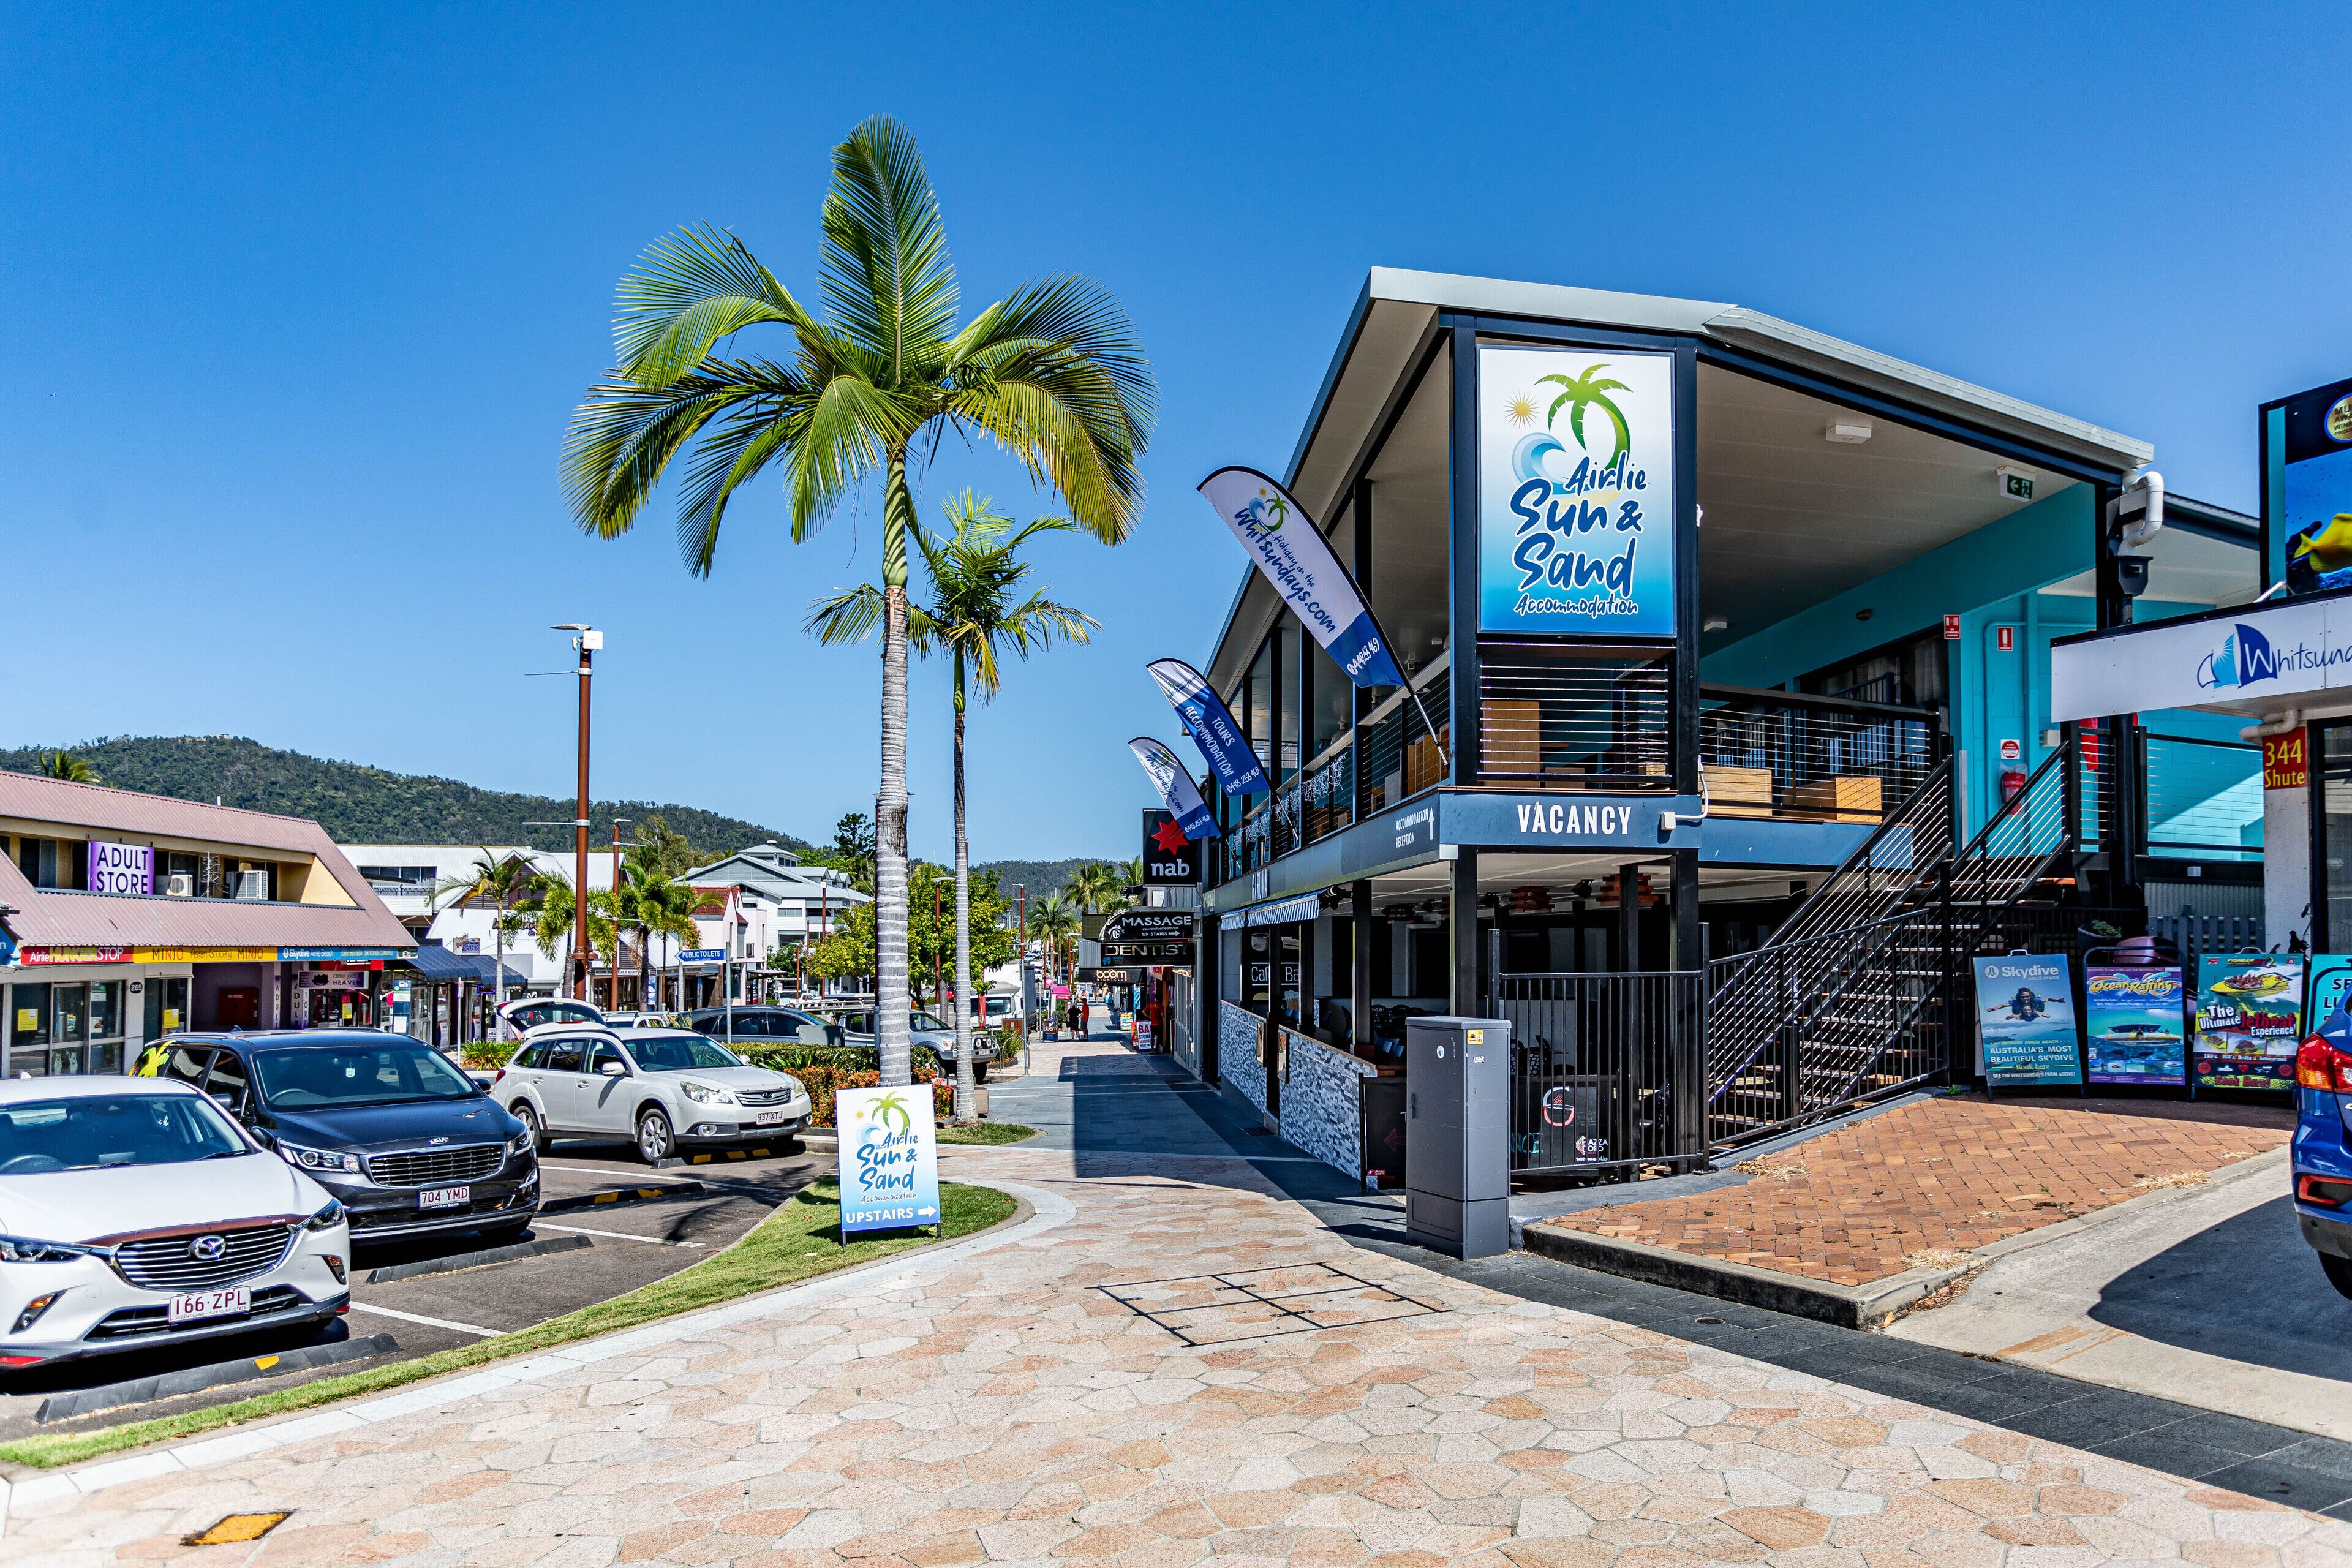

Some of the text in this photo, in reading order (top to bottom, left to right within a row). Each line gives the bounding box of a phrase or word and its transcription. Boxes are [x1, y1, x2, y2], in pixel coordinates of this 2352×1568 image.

[1565, 451, 1646, 497] Airlie
[1510, 478, 1643, 537] Sun &
[1274, 535, 1314, 587] Holiday in the
[1513, 532, 1636, 597] Sand
[1234, 508, 1337, 634] Whitsundays.com
[1515, 593, 1638, 617] Accommodation
[1368, 637, 1379, 655] 469
[1212, 716, 1235, 747] TOURS
[1185, 706, 1234, 777] ACCOMMODATION
[2265, 739, 2302, 767] 344
[1145, 754, 1184, 813] Whitsundays.com
[1226, 766, 1259, 793] 0448 253 469
[2264, 769, 2305, 788] Shute
[1185, 823, 1196, 833] 0448
[1194, 818, 1203, 827] 253
[1395, 808, 1428, 831] ACCOMMODATION
[1517, 804, 1632, 835] VACANCY
[1396, 831, 1415, 848] RECEPTION
[96, 846, 148, 870] ADULT
[1151, 859, 1189, 876] nab
[96, 870, 148, 894] STORE
[1122, 916, 1191, 927] MASSAGE
[29, 947, 124, 962] Airlie HUNGER STOP
[153, 948, 184, 961] MINJO
[238, 948, 263, 960] MINJO
[289, 949, 310, 959] Skydive
[1104, 944, 1186, 956] DENTIST
[1096, 968, 1127, 979] boom
[1251, 966, 1299, 982] Caf Ba
[2001, 965, 2059, 979] Skydive
[2089, 978, 2174, 997] Ocean Rafting
[2199, 1012, 2295, 1030] Ultimate Jetboat
[2207, 1005, 2234, 1019] The
[1139, 1024, 1150, 1034] BA
[2215, 1075, 2240, 1086] Book
[881, 1128, 919, 1149] Airlie
[856, 1143, 918, 1169] Sun &
[859, 1164, 915, 1193] Sand
[861, 1190, 918, 1204] Accommodation
[846, 1207, 914, 1224] UPSTAIRS
